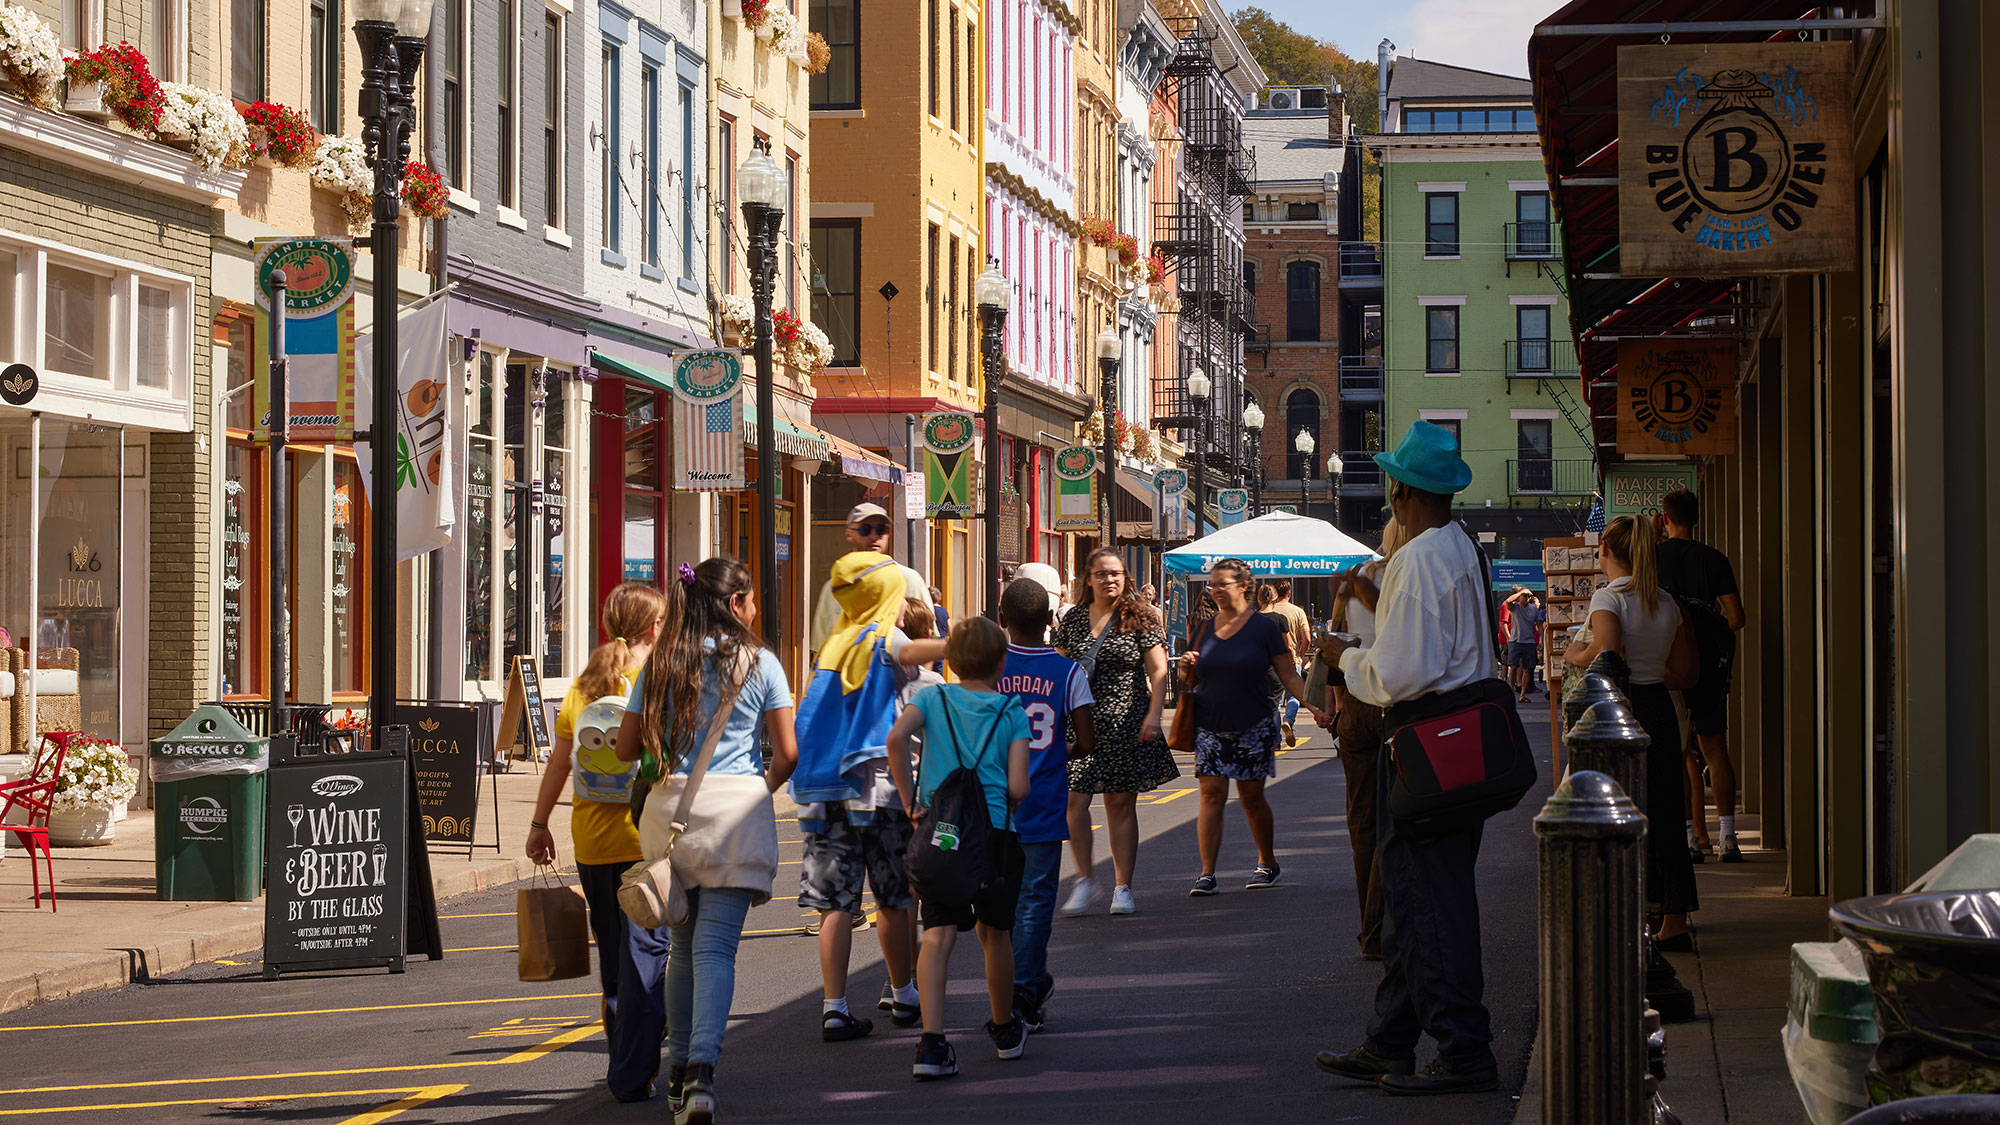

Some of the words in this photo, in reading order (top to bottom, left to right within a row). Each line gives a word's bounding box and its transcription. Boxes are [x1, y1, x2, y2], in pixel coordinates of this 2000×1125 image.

[1704, 127, 1768, 192] B
[1646, 145, 1703, 233] BLUE
[1772, 143, 1827, 231] OVEN
[1705, 213, 1731, 229] FARM
[1740, 214, 1766, 229] FOOD
[1696, 224, 1773, 251] BAKERY
[266, 240, 341, 266] FINDLAY
[287, 280, 342, 307] ARKET
[681, 351, 734, 369] FINDLAY
[686, 378, 735, 397] MARKET
[1659, 380, 1692, 413] B
[260, 410, 341, 427] Bnvenue
[1631, 388, 1659, 433] BLUE
[1693, 389, 1722, 434] OVEN
[929, 414, 968, 428] FINDLAY
[932, 435, 969, 450] MARKET
[1655, 428, 1693, 443] BAKERY
[687, 470, 732, 481] Welcome
[1615, 477, 1687, 491] MAKERS
[227, 497, 238, 517] The
[1615, 492, 1664, 506] BAKE
[238, 525, 250, 550] Bags
[345, 535, 356, 559] Bags
[226, 548, 239, 574] Lady
[334, 557, 347, 581] Lady
[1245, 558, 1282, 569] stom
[1285, 558, 1340, 571] Jewelry
[58, 579, 103, 607] LUCCA
[994, 675, 1055, 698] JORDAN
[176, 745, 230, 755] RECYCLE
[411, 738, 460, 754] UCCA
[427, 780, 452, 788] DECOR
[429, 771, 450, 779] GIFTS
[320, 781, 355, 792] Wines
[418, 789, 448, 797] NITURE
[180, 808, 228, 816] RUMPKE
[307, 802, 381, 846] WINE
[297, 848, 369, 897] BEER
[288, 901, 305, 921] BY
[310, 899, 339, 919] THE
[343, 894, 384, 918] GLASS
[297, 927, 321, 937] OUTSIDE
[322, 926, 338, 936] ONLY
[339, 925, 357, 935] UNTIL
[358, 924, 372, 934] 4PM
[300, 939, 332, 951] IN/OUTSIDE
[334, 938, 353, 948] AFTER
[355, 937, 368, 947] 4PM
